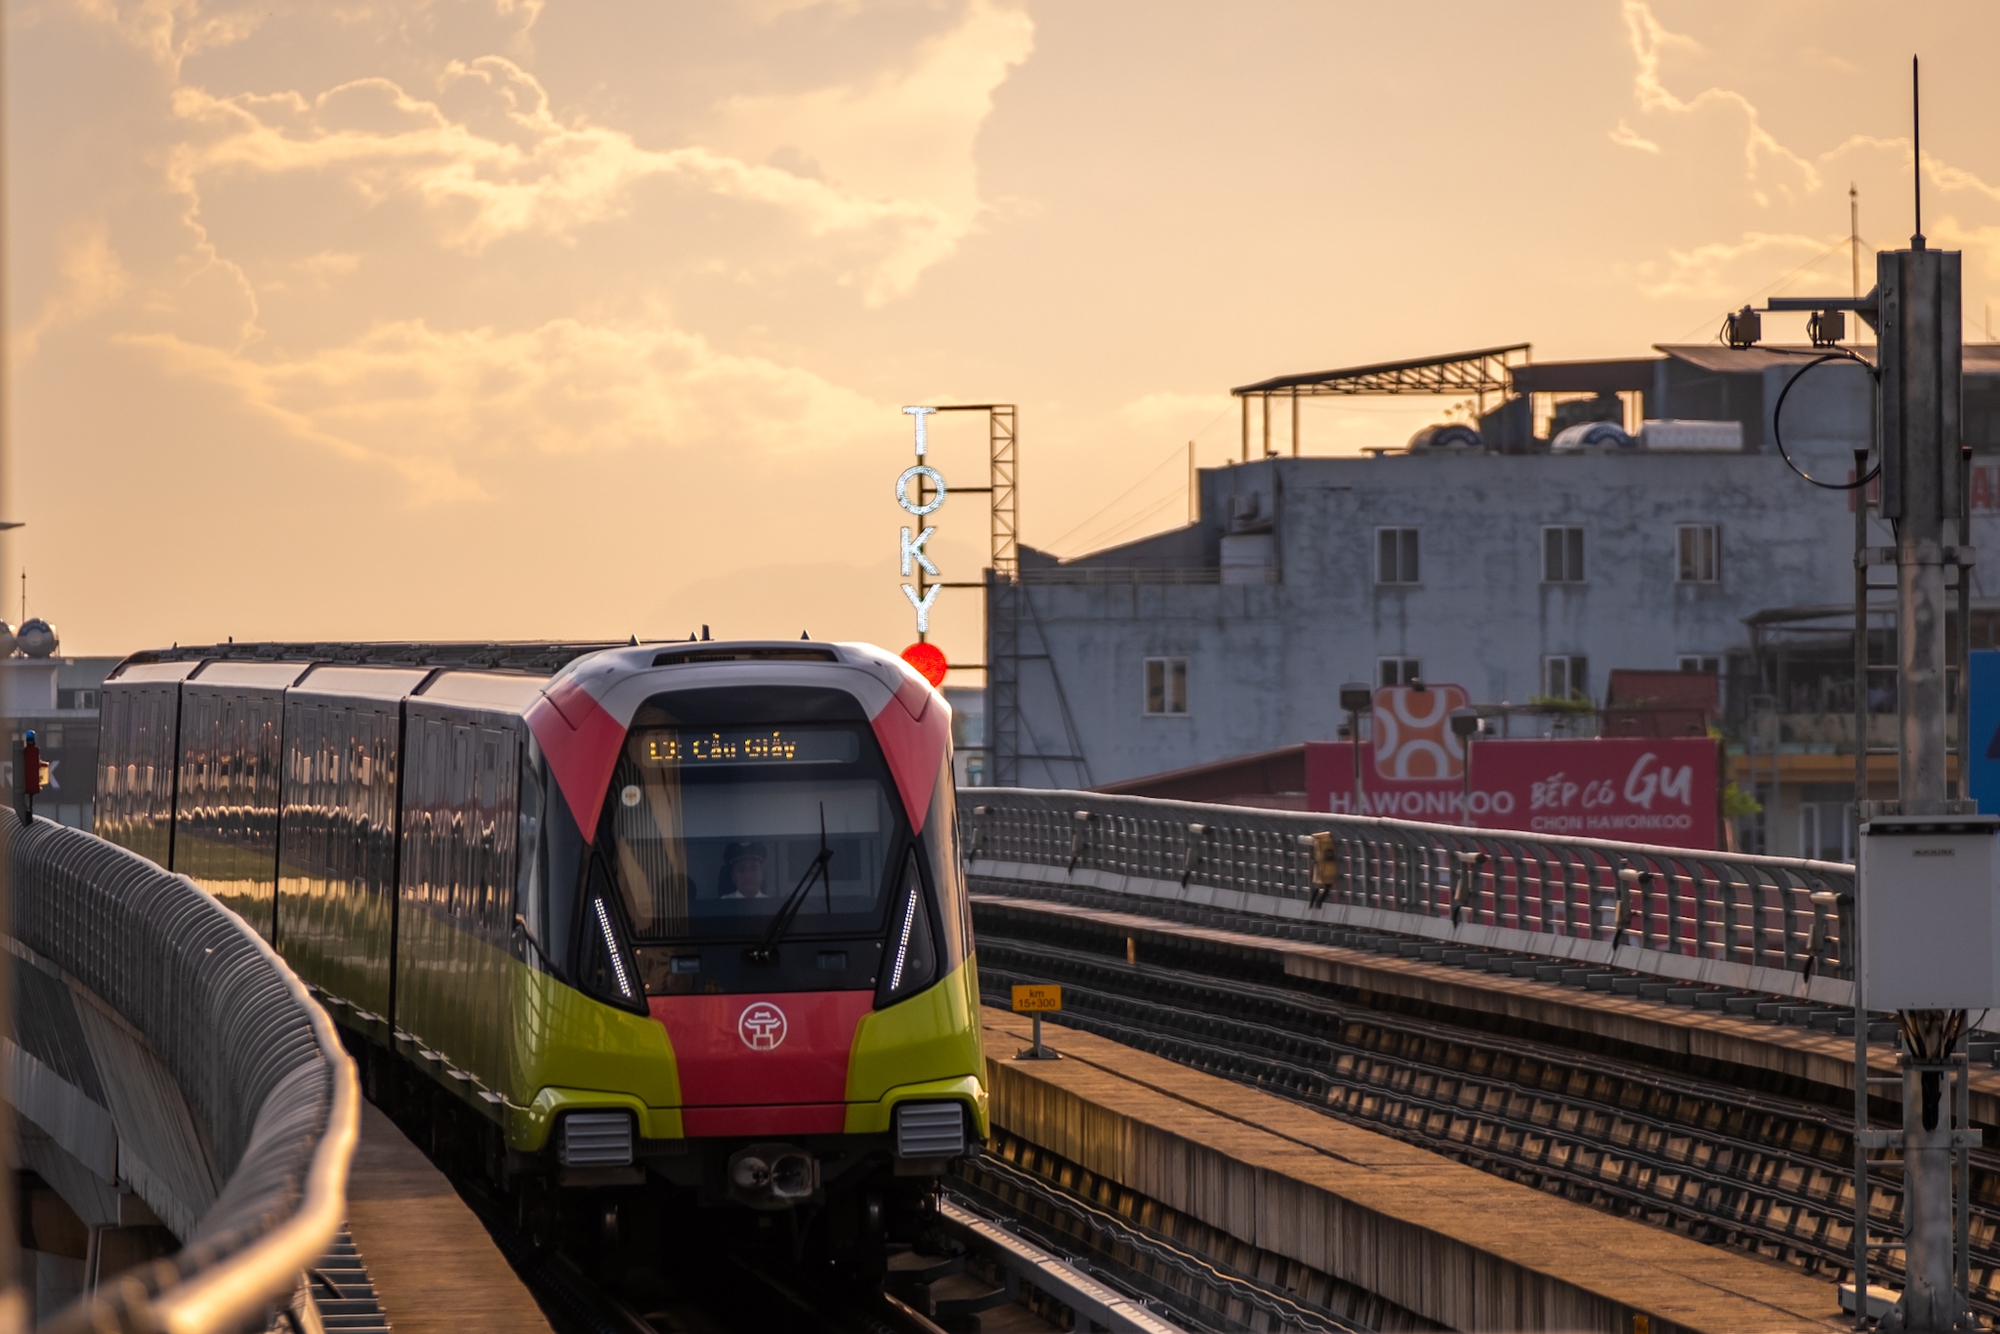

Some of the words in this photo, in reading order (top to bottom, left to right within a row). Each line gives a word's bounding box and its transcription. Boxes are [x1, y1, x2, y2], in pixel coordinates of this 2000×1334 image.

[1529, 772, 1579, 810] BẾP
[1329, 790, 1515, 815] HAWONKOO
[1530, 816, 1582, 832] CHỌN
[1586, 814, 1693, 829] HAWONKOO
[1029, 989, 1044, 998] km
[1019, 998, 1056, 1008] 15+300
